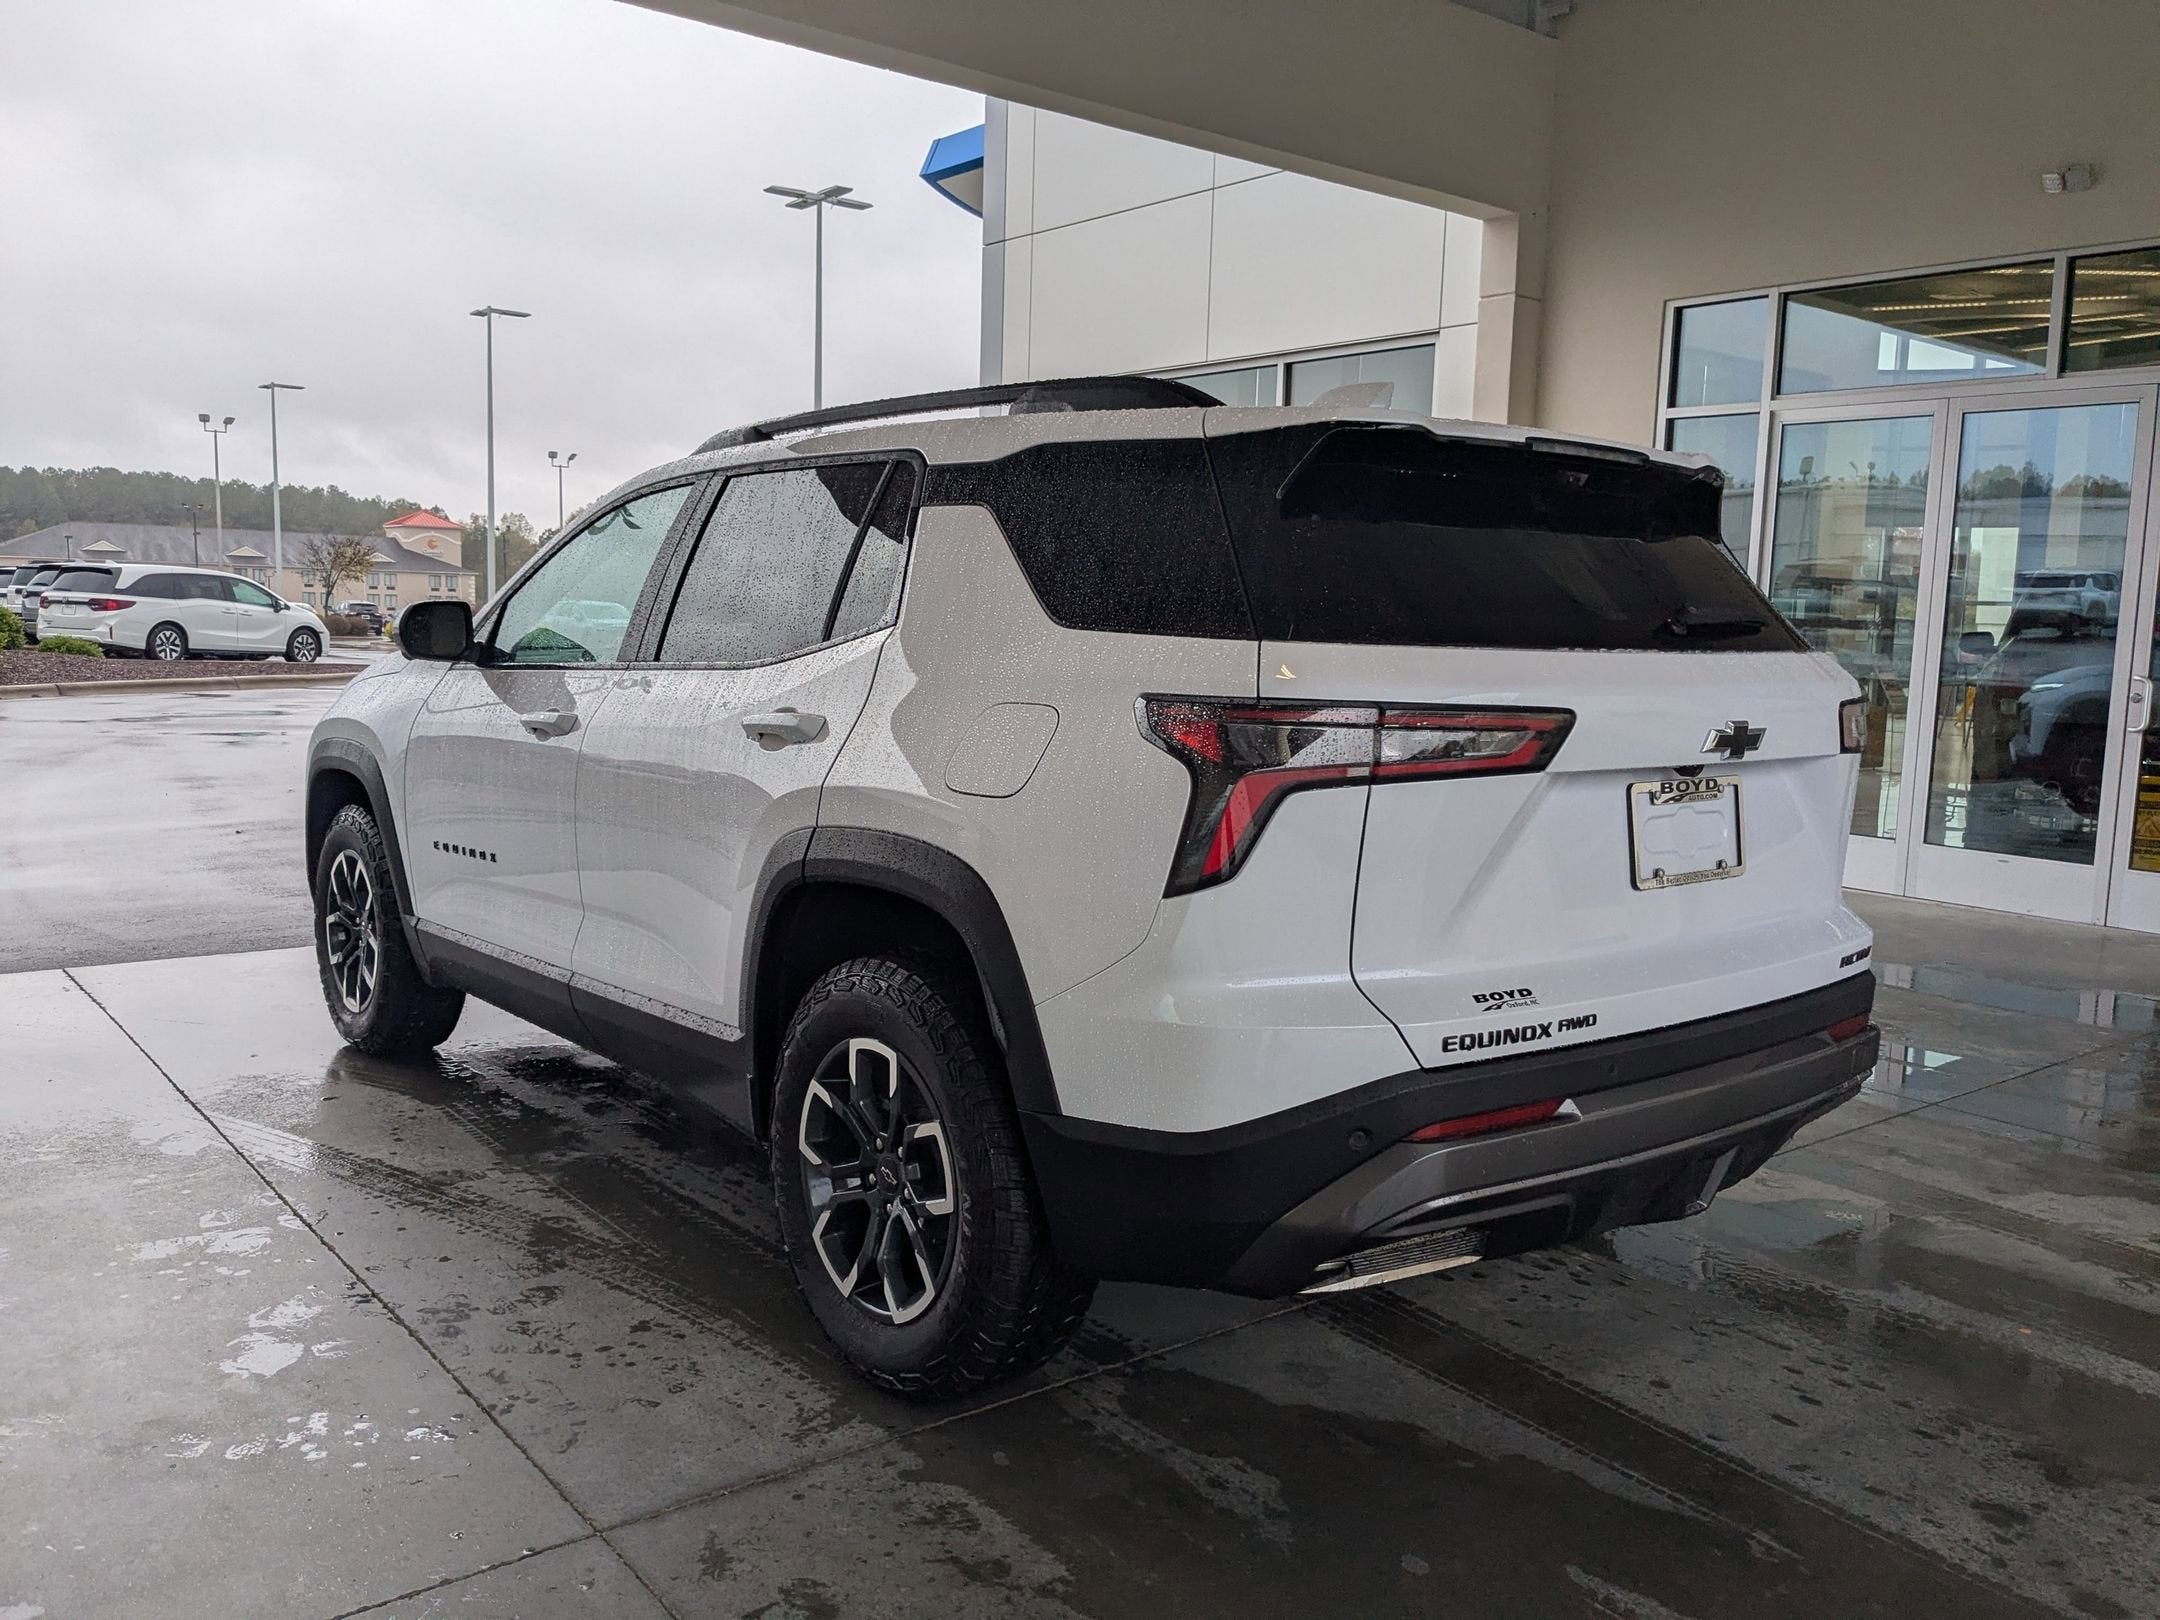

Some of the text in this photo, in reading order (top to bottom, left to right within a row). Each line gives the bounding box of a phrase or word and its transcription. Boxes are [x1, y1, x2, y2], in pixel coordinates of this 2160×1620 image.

[1660, 778, 1718, 794] BOYD
[433, 840, 497, 863] EQUINOX
[1472, 988, 1533, 1004] BOYD
[1441, 1013, 1598, 1053] EQUINOX AWD
